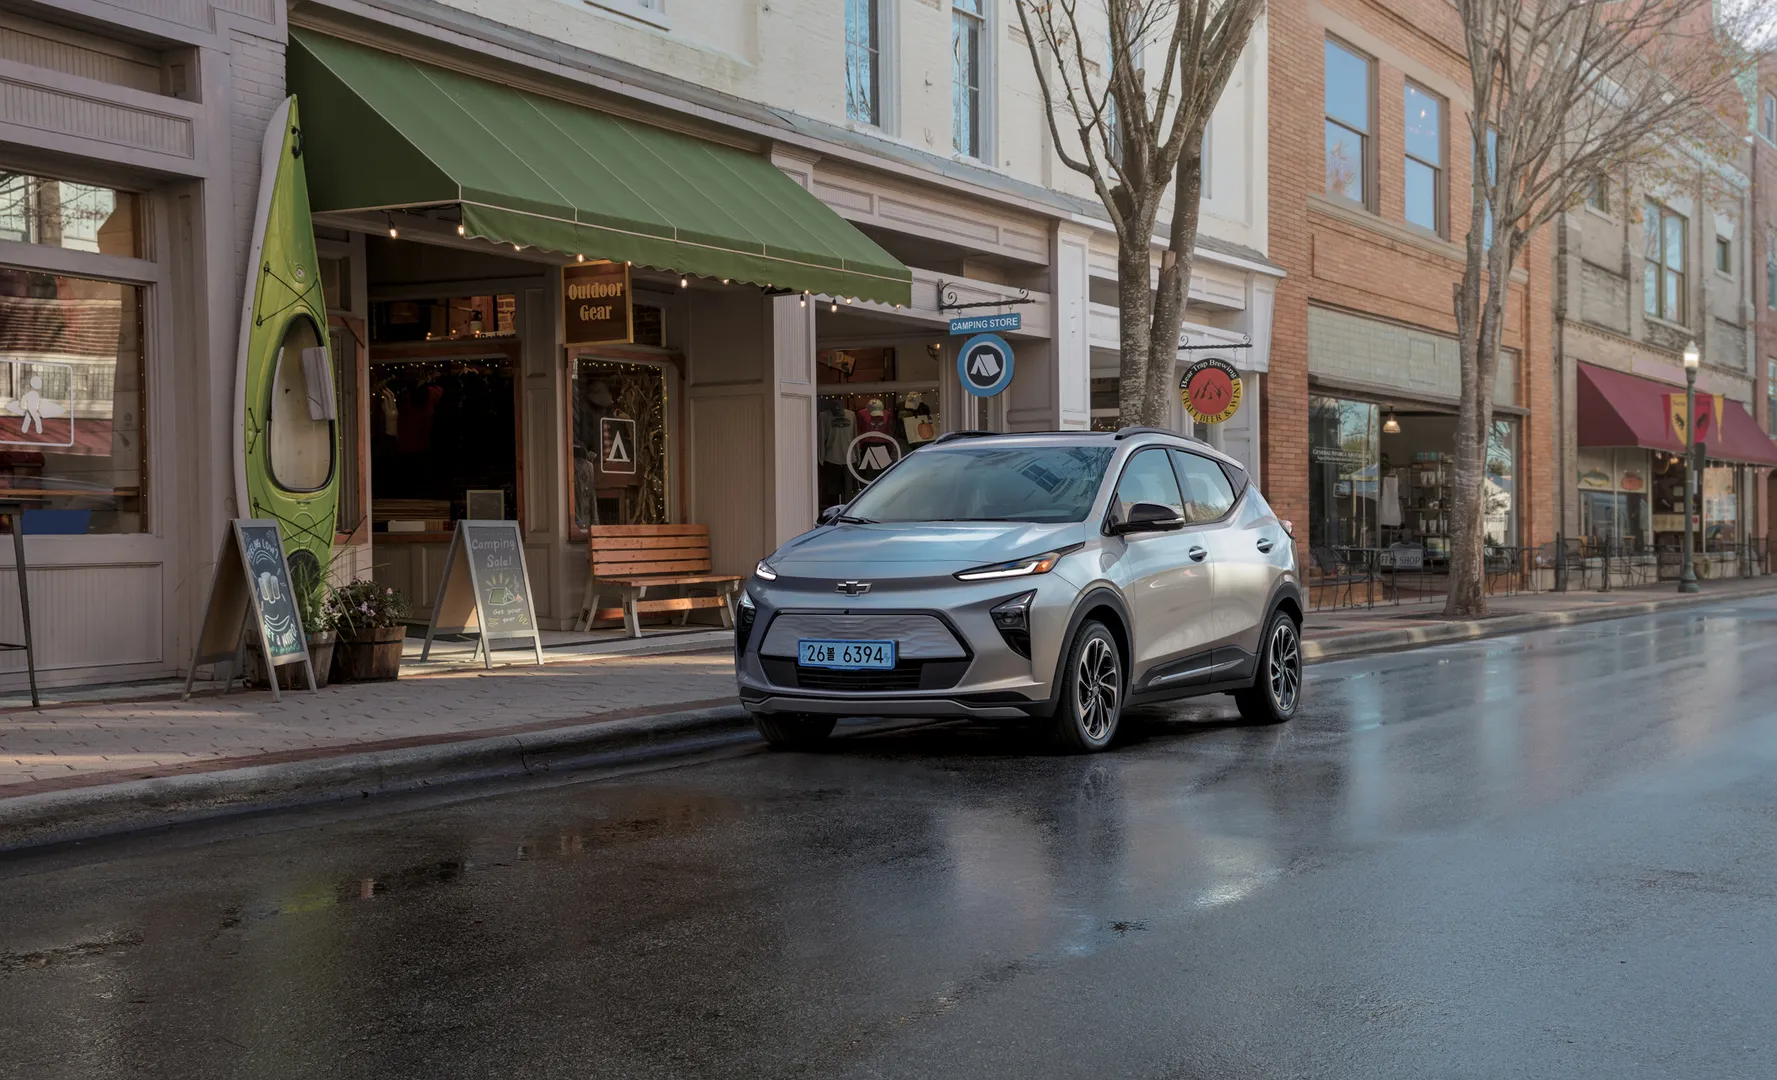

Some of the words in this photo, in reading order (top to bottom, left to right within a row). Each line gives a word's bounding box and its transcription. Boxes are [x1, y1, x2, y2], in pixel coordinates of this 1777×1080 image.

[568, 282, 623, 300] Outdoor
[580, 304, 612, 321] Gear
[951, 319, 988, 331] CAMPING
[989, 317, 1018, 328] STORE
[1181, 370, 1193, 388] Bear
[1192, 361, 1208, 372] Trap
[1209, 359, 1237, 379] Brewing
[1181, 390, 1199, 418] CRAFT
[1199, 413, 1222, 423] BEER
[1223, 409, 1231, 417] &
[1230, 382, 1241, 407] WINE
[471, 538, 515, 552] Camping
[486, 554, 512, 568] Sale!
[1399, 555, 1421, 565] SHOP
[492, 608, 504, 616] Get
[842, 645, 884, 664] 6394
